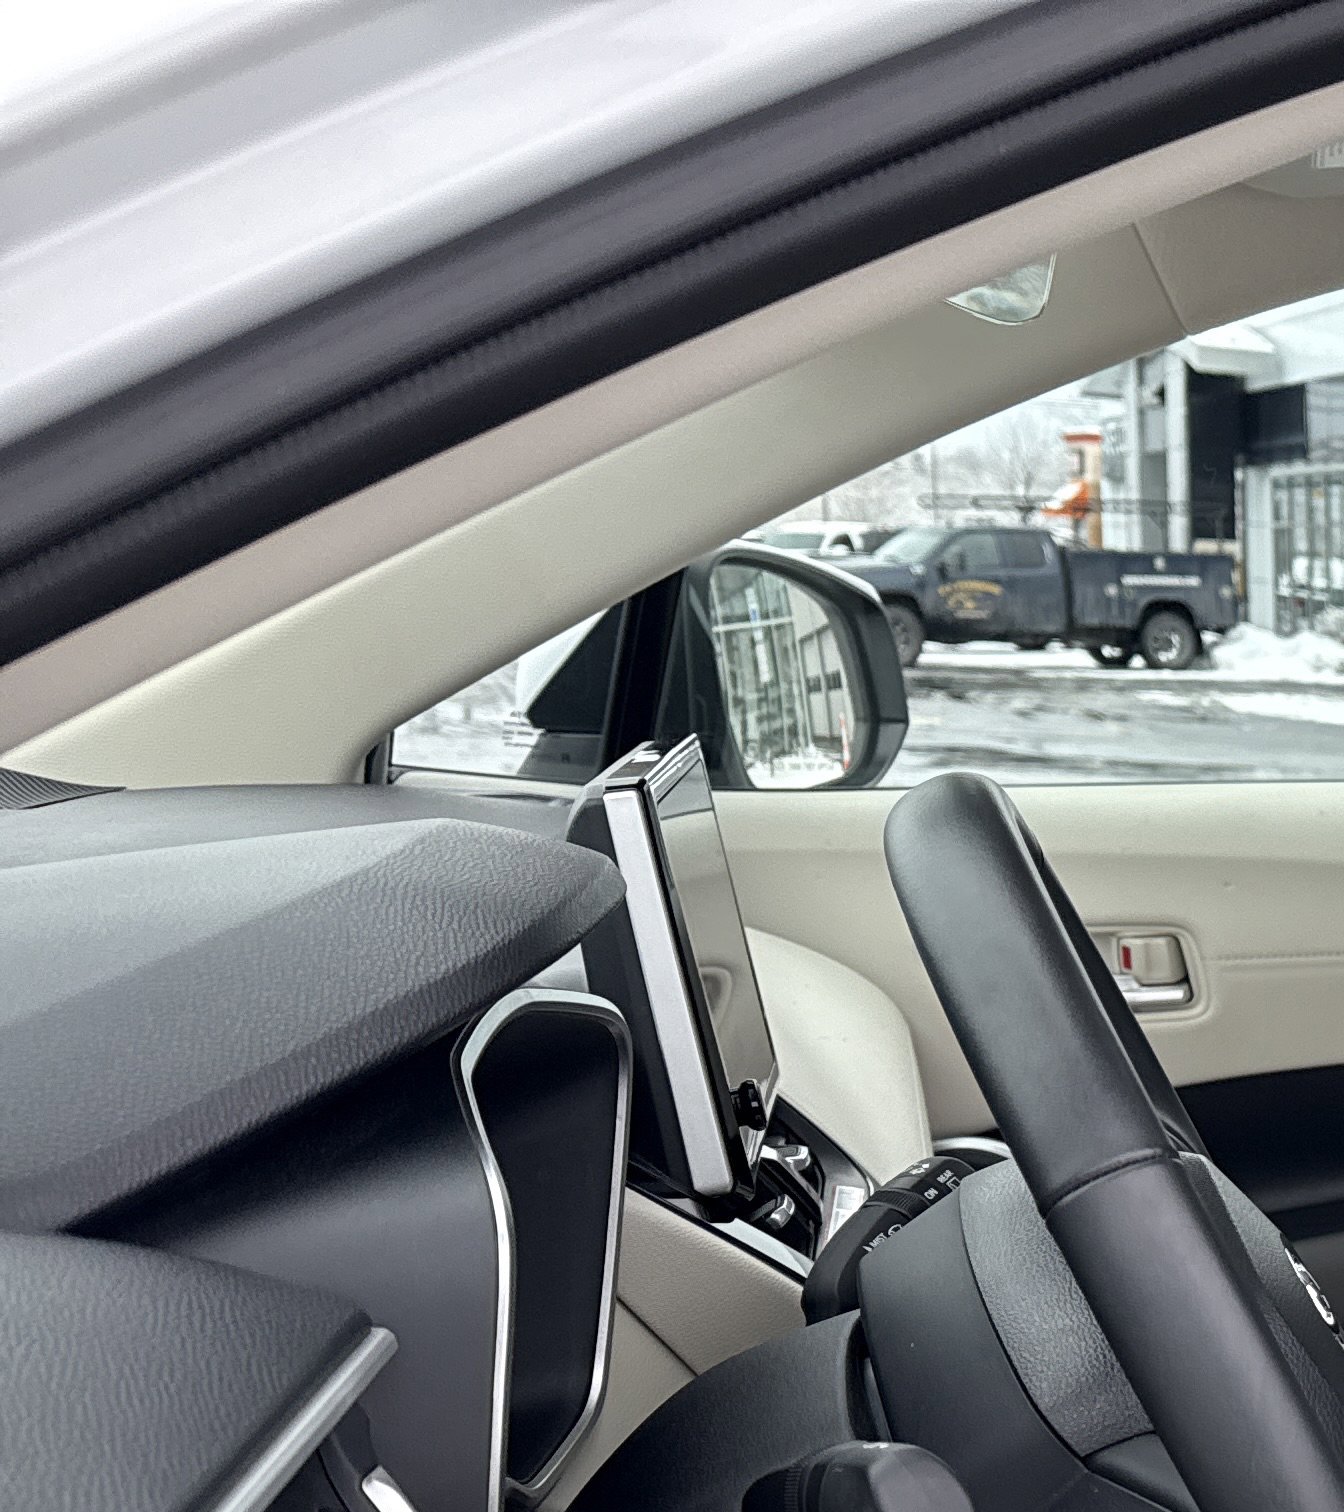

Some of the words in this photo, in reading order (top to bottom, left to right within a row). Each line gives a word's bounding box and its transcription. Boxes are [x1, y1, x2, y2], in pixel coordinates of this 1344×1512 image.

[936, 1169, 955, 1184] REAR
[924, 1188, 939, 1200] ON
[868, 1232, 888, 1248] MIST
